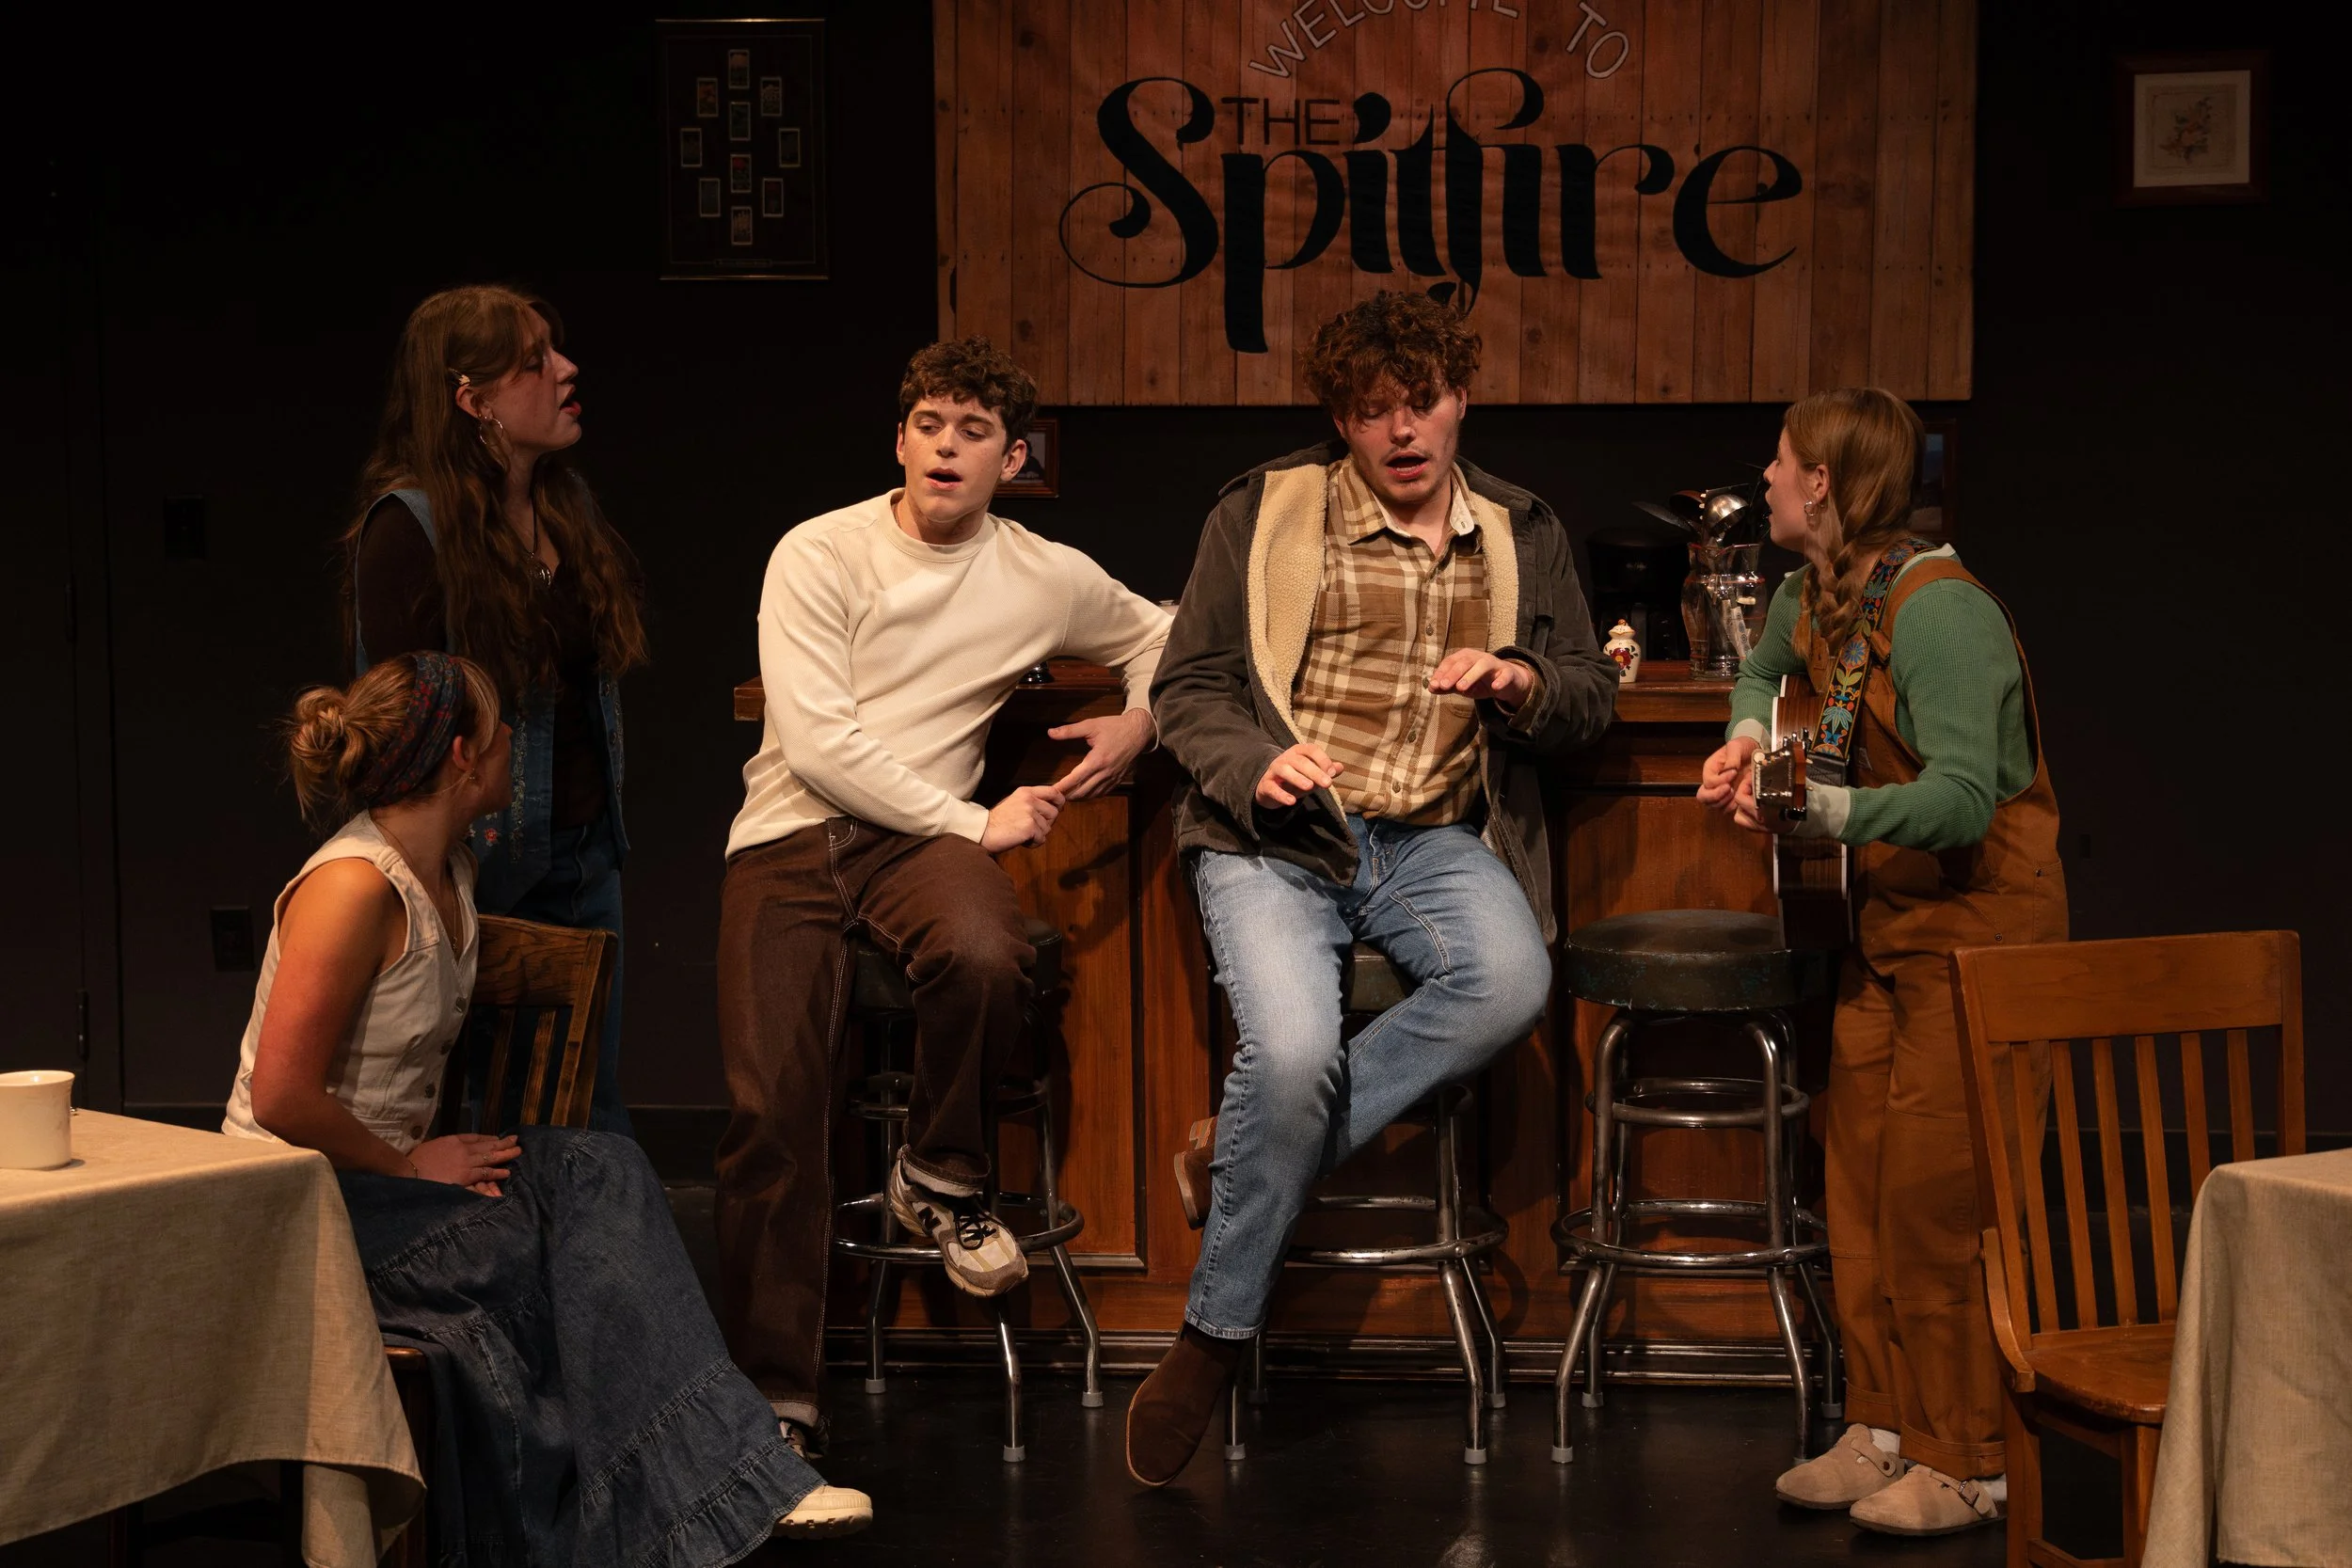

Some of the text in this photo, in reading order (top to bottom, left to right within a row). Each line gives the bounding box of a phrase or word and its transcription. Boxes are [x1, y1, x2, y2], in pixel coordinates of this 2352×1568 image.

[1565, 2, 1629, 79] TO
[1221, 97, 1341, 145] THE
[1059, 68, 1803, 353] Spitfire
